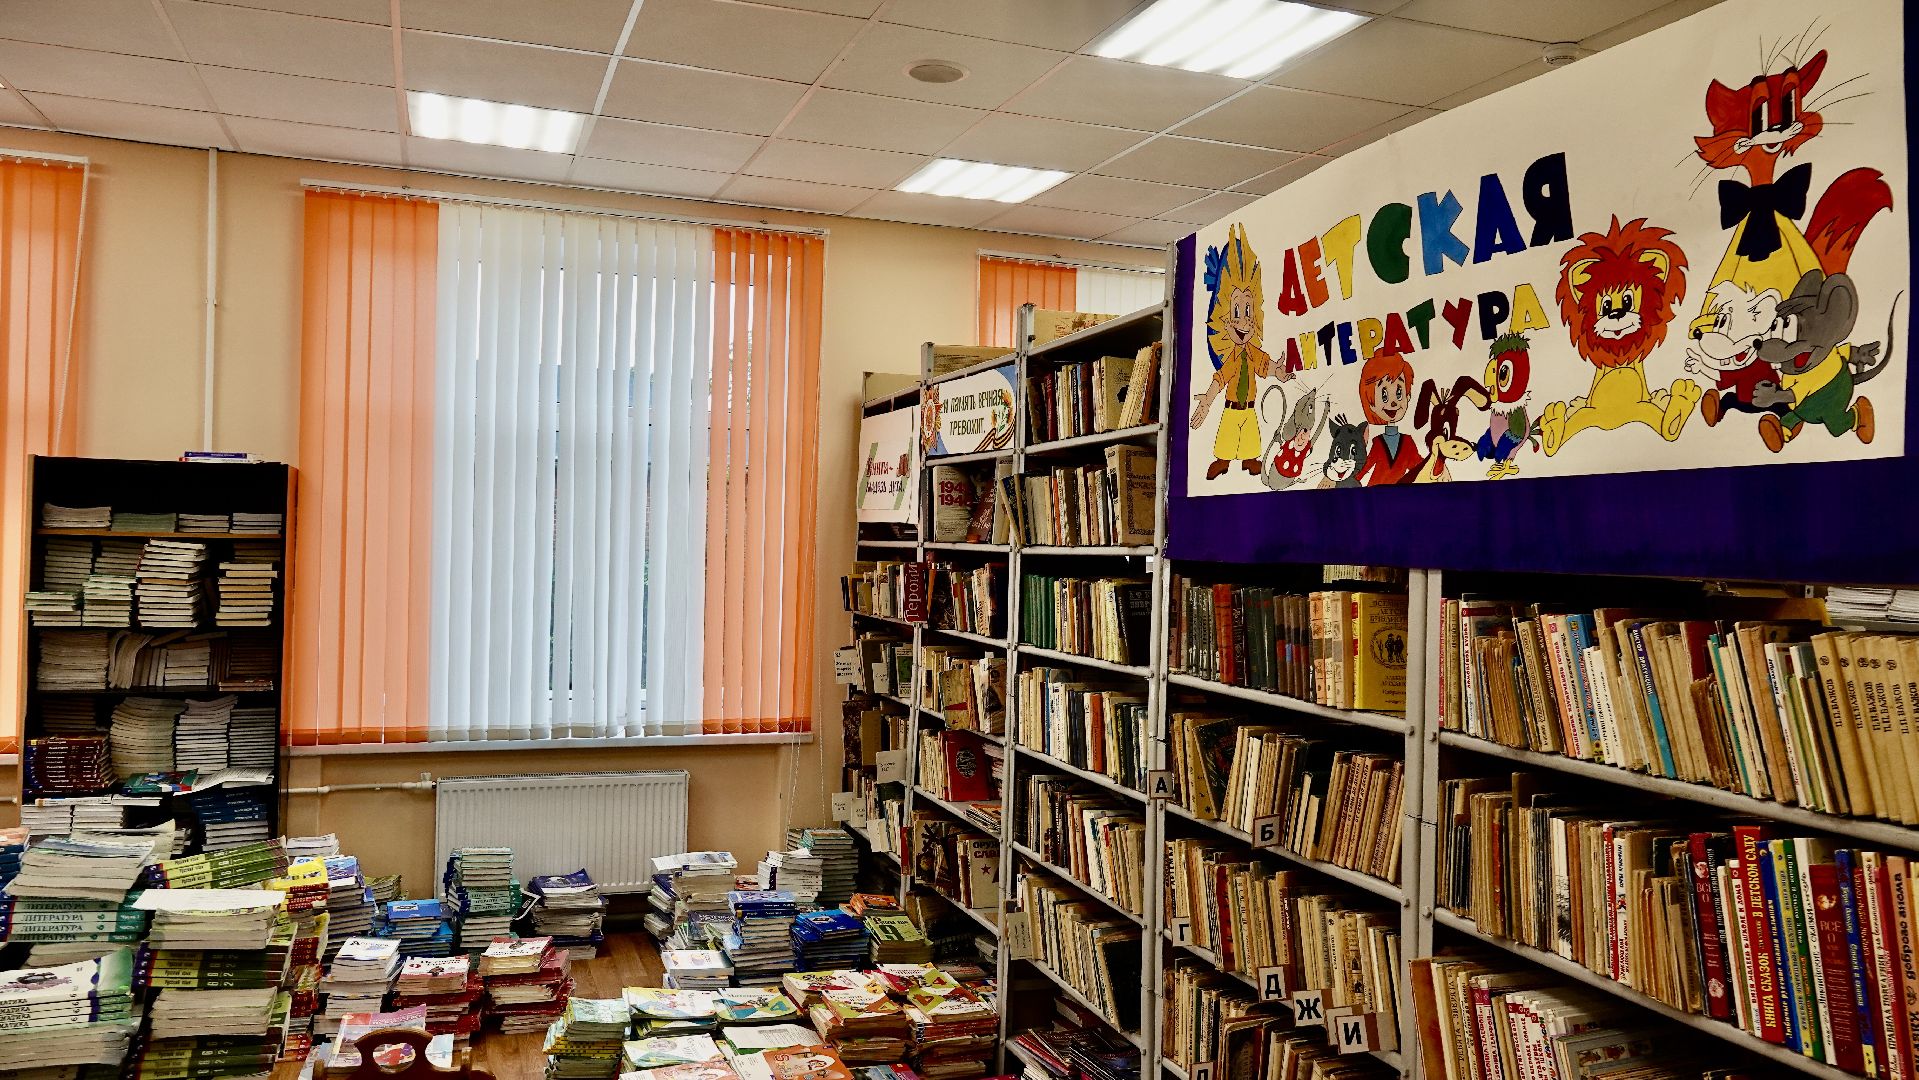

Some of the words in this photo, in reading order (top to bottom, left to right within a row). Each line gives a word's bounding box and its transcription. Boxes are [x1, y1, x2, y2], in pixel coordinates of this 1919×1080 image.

[1277, 152, 1574, 316] ДЕТСКАЯ
[1286, 283, 1550, 373] ЛИТЕРАТУРА
[1155, 776, 1168, 794] А
[1260, 823, 1275, 842] Б
[1742, 833, 1757, 861] САДУ
[1745, 862, 1763, 909] ДЕТСКОМ
[1753, 910, 1763, 918] В
[20, 924, 83, 932] ЛИТЕРАТУРА
[879, 924, 905, 941] 9
[1179, 923, 1190, 941] Г
[1739, 915, 1747, 941] ШКОЛЕ
[1756, 951, 1773, 992] СКАЗОК
[1265, 974, 1282, 999] Д
[1296, 998, 1322, 1021] Ж
[1761, 994, 1777, 1028] КНИГА
[1343, 1021, 1362, 1046] И
[1520, 1017, 1528, 1043] ХОЛМСЕ
[1883, 1007, 1896, 1050] ПРАВИЛА
[1525, 1044, 1534, 1074] ШЕРЛОКЕ
